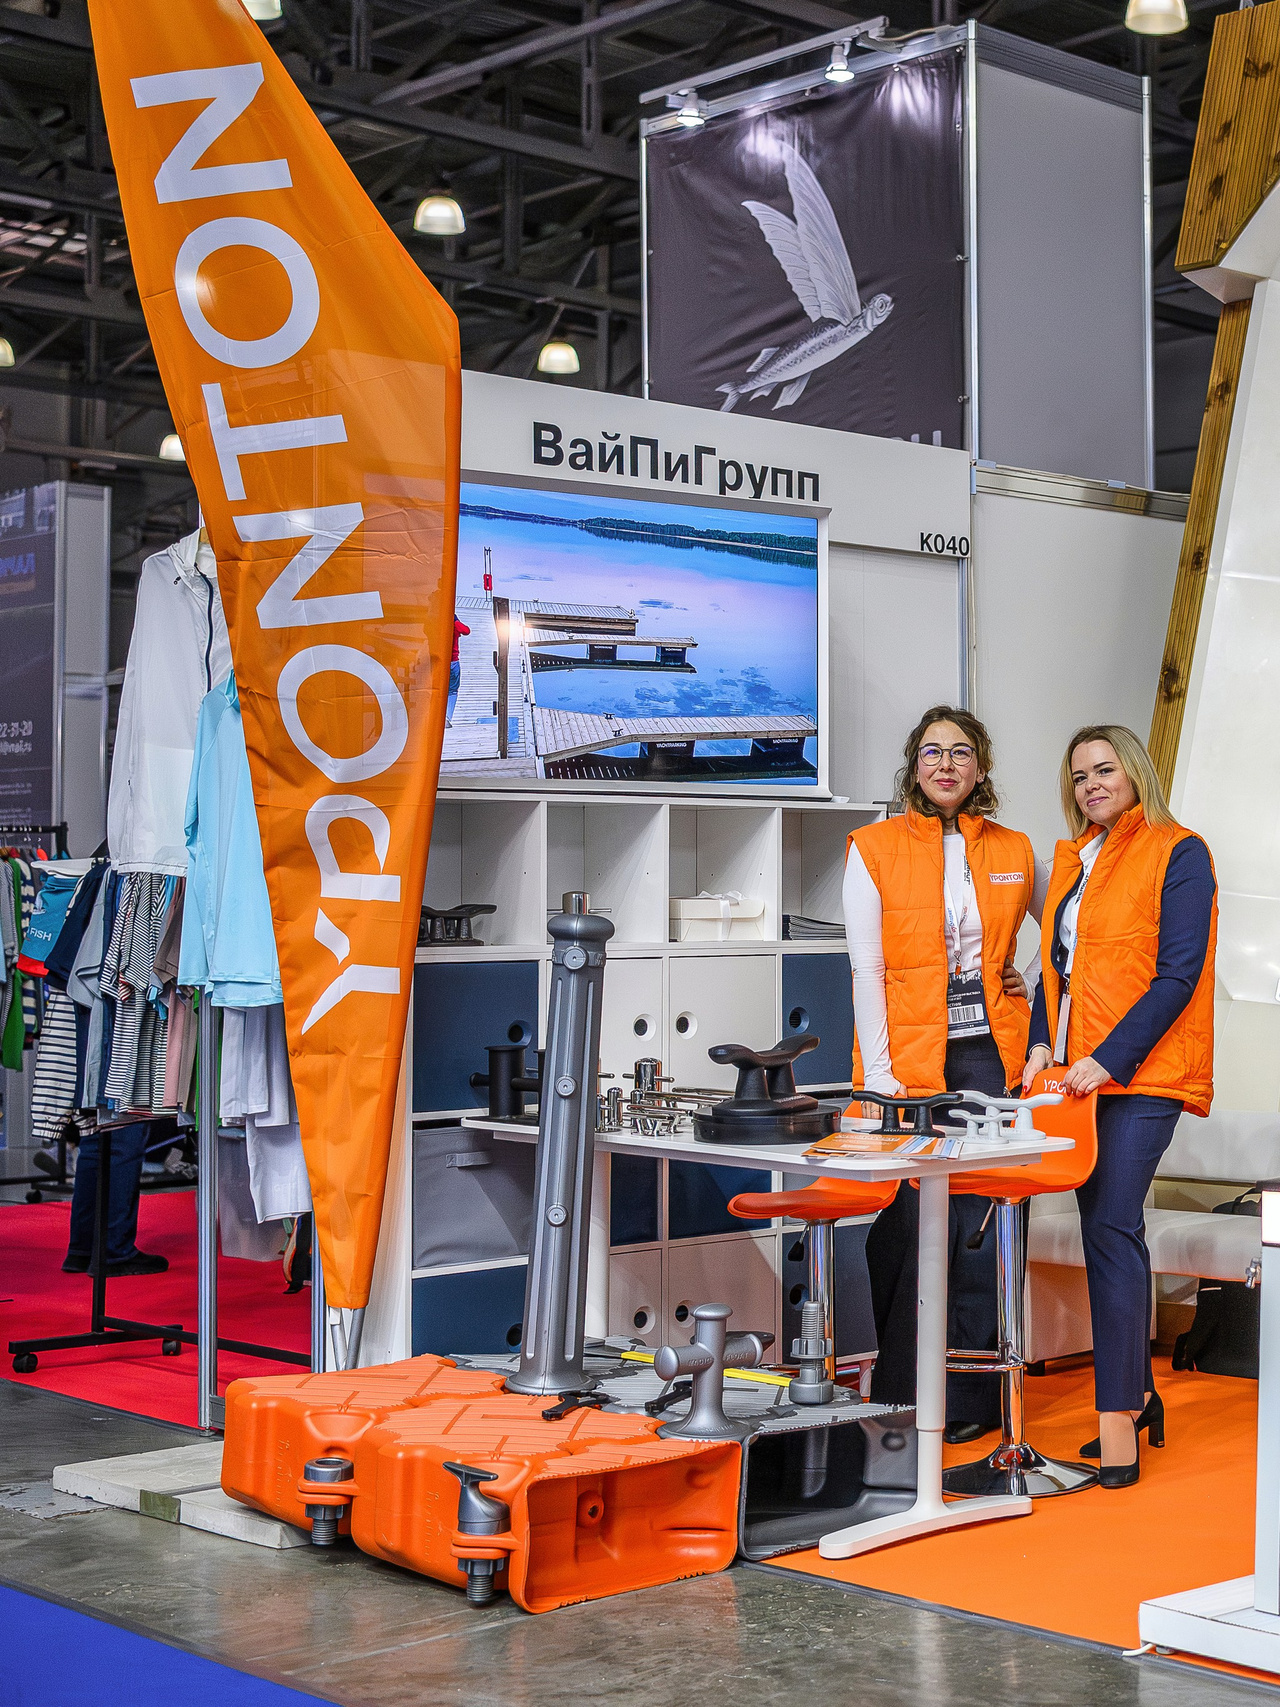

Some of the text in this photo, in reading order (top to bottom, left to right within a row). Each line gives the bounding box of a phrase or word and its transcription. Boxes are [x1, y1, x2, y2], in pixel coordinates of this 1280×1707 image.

[533, 421, 820, 502] ВайПиГрупп
[129, 61, 409, 1035] YPONTON
[919, 532, 970, 557] K040
[989, 873, 1024, 882] YPONTON
